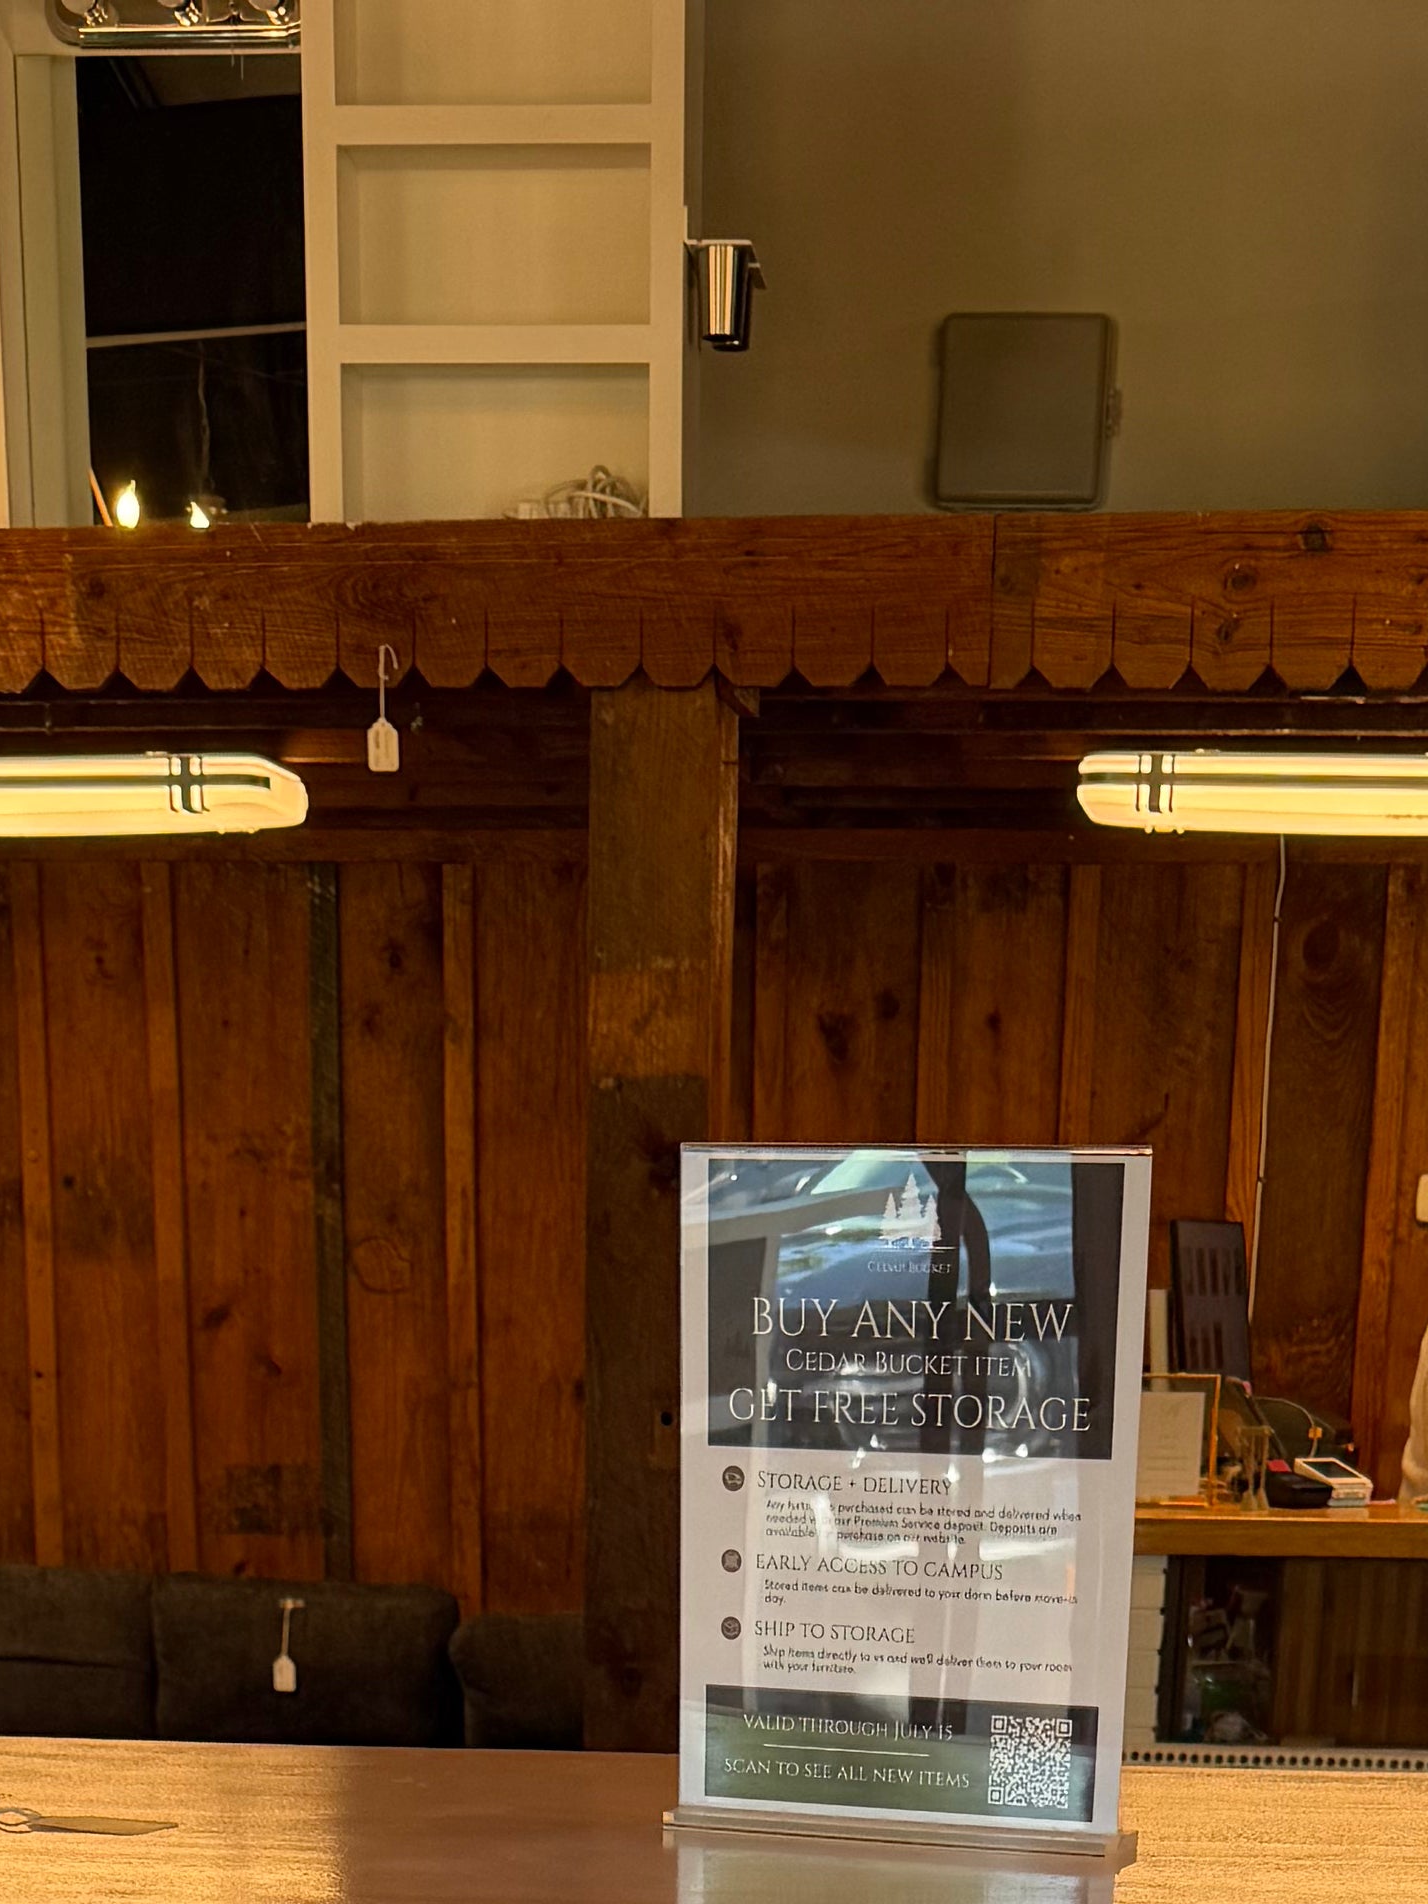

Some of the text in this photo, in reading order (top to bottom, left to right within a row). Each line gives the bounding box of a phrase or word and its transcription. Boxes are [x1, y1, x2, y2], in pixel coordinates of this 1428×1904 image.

[752, 1297, 1074, 1344] BUY ANY NEW
[785, 1348, 1032, 1378] CEDAR BUCKET ITEM
[729, 1387, 1092, 1433] GET FREE STORAGE
[757, 1470, 843, 1492] STORAGE
[863, 1476, 953, 1497] DELIVERY
[837, 1500, 894, 1516] purchased
[919, 1502, 934, 1516] be
[974, 1505, 995, 1519] and
[854, 1515, 899, 1529] Premium
[900, 1516, 940, 1530] Service
[755, 1553, 1003, 1581] EARLY ACCESS TO CAMPUS
[764, 1578, 799, 1592] Stored
[801, 1582, 829, 1593] items
[831, 1584, 852, 1594] can
[854, 1582, 869, 1595] be
[871, 1583, 922, 1598] delivered
[924, 1586, 936, 1599] to
[754, 1620, 916, 1644] SHIP TO STORAGE
[743, 1713, 795, 1732] VALID
[798, 1717, 888, 1738] THROUGH
[893, 1720, 933, 1742] JULY
[724, 1757, 970, 1789] SCAN TO SEE ALL NEW ITEMS
